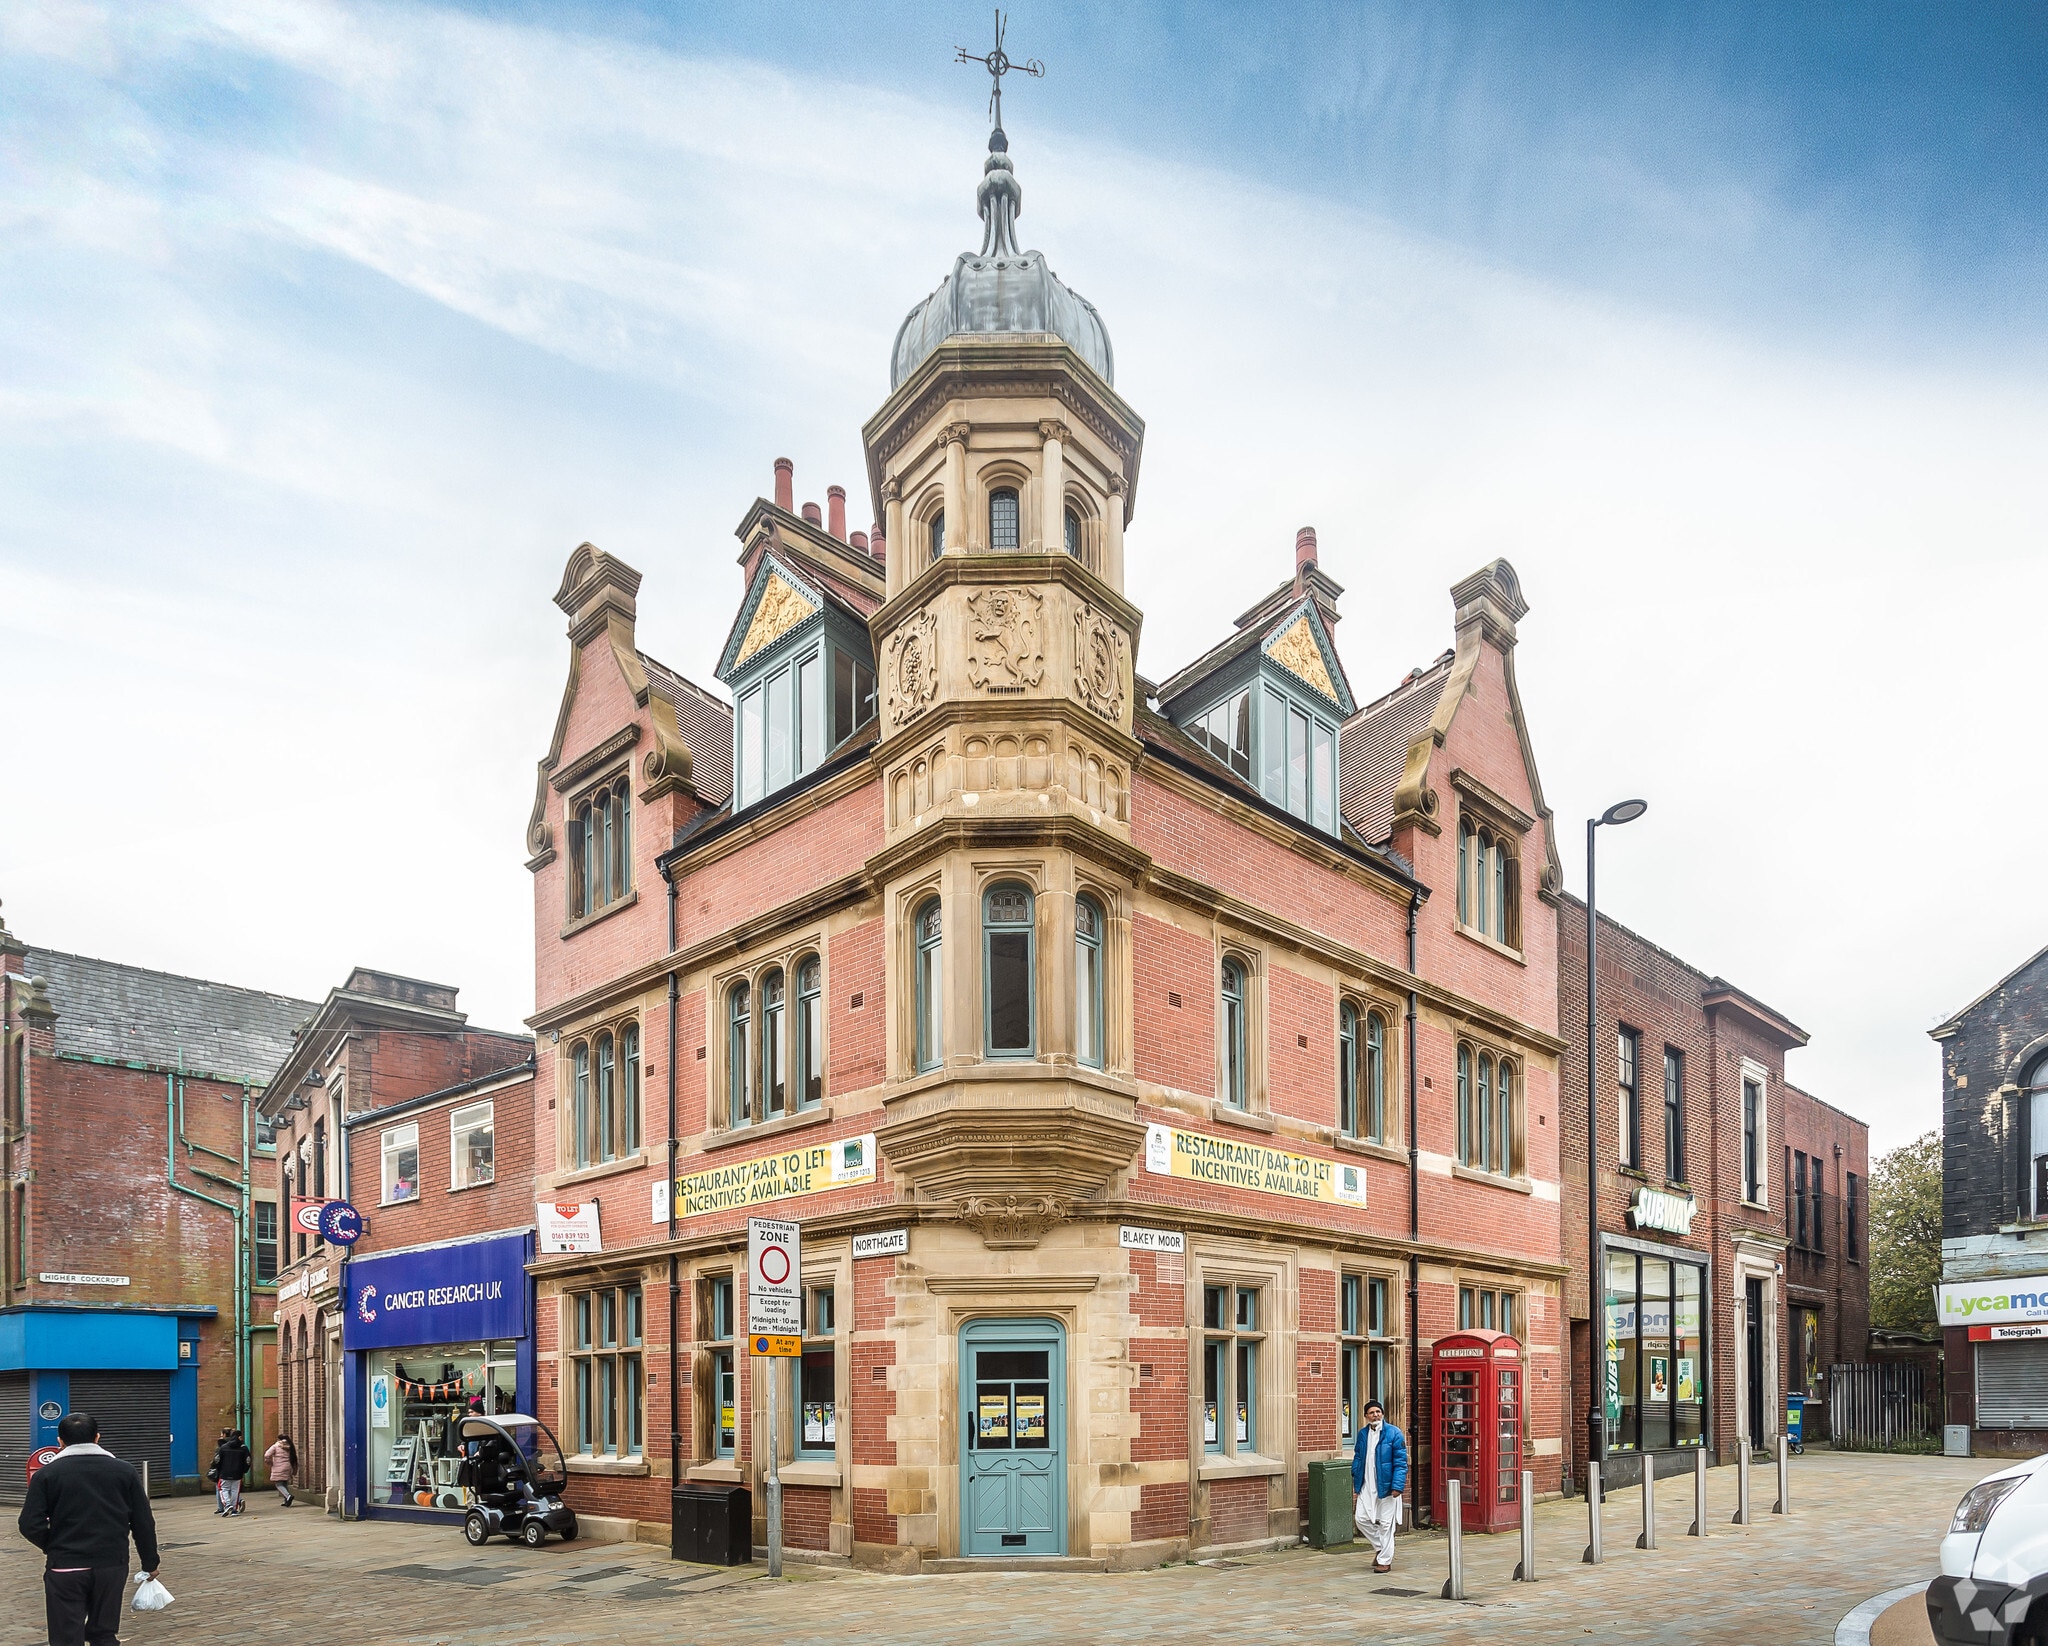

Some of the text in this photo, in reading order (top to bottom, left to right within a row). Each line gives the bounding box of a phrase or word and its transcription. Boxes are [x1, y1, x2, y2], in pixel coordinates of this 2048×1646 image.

[1177, 1133, 1331, 1181] RESTAURANT/BAR TO LET
[675, 1148, 825, 1197] RESTAURANT/BAR TO LET
[1191, 1158, 1319, 1197] INCENTIVES AVAILABLE
[686, 1173, 811, 1213] INCENTIVES AVAILABLE
[1633, 1187, 1697, 1235] SUBWAY
[753, 1221, 795, 1231] PEDESTRIAN
[760, 1231, 789, 1243] ZONE
[855, 1234, 904, 1252] NORTHGATE
[1123, 1231, 1181, 1248] BLAKEY MOOR
[45, 1274, 125, 1284] HIGHER COCKCROFT
[384, 1280, 502, 1311] CANCER RESEARCH UK
[769, 1286, 792, 1294] vehicles
[760, 1298, 781, 1306] Except
[764, 1306, 786, 1315] loading
[751, 1316, 778, 1325] Midnight
[772, 1325, 798, 1333] Midnight
[1998, 1327, 2042, 1337] Telegraph
[1441, 1349, 1481, 1357] TELEPHONE
[1606, 1305, 1619, 1410] SUBWAY
